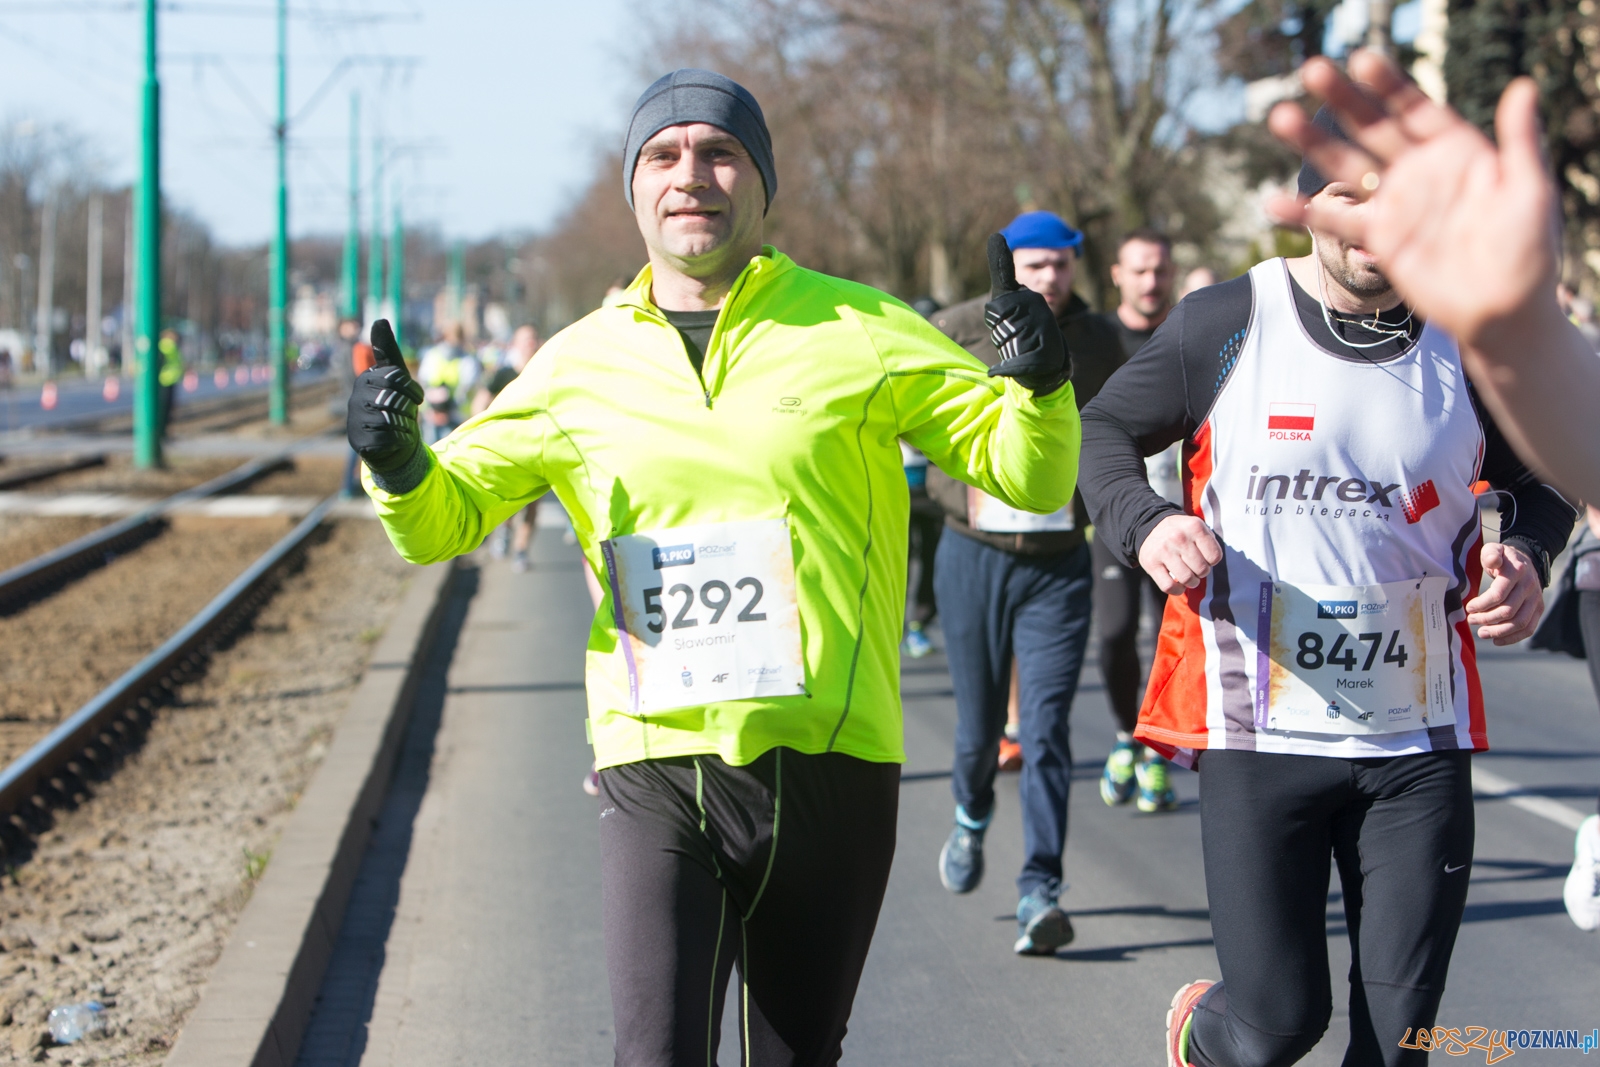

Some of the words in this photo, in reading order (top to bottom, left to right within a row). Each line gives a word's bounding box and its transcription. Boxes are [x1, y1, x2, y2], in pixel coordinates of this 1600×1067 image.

[1269, 431, 1311, 441] POLSKA
[1246, 465, 1402, 508] intrex
[1245, 504, 1283, 516] klub
[669, 548, 693, 561] PKO
[643, 577, 767, 634] 5292
[1334, 604, 1355, 615] PKO
[674, 632, 737, 651] Sławomir
[1296, 629, 1408, 672] 8474
[1336, 678, 1375, 689] Marek
